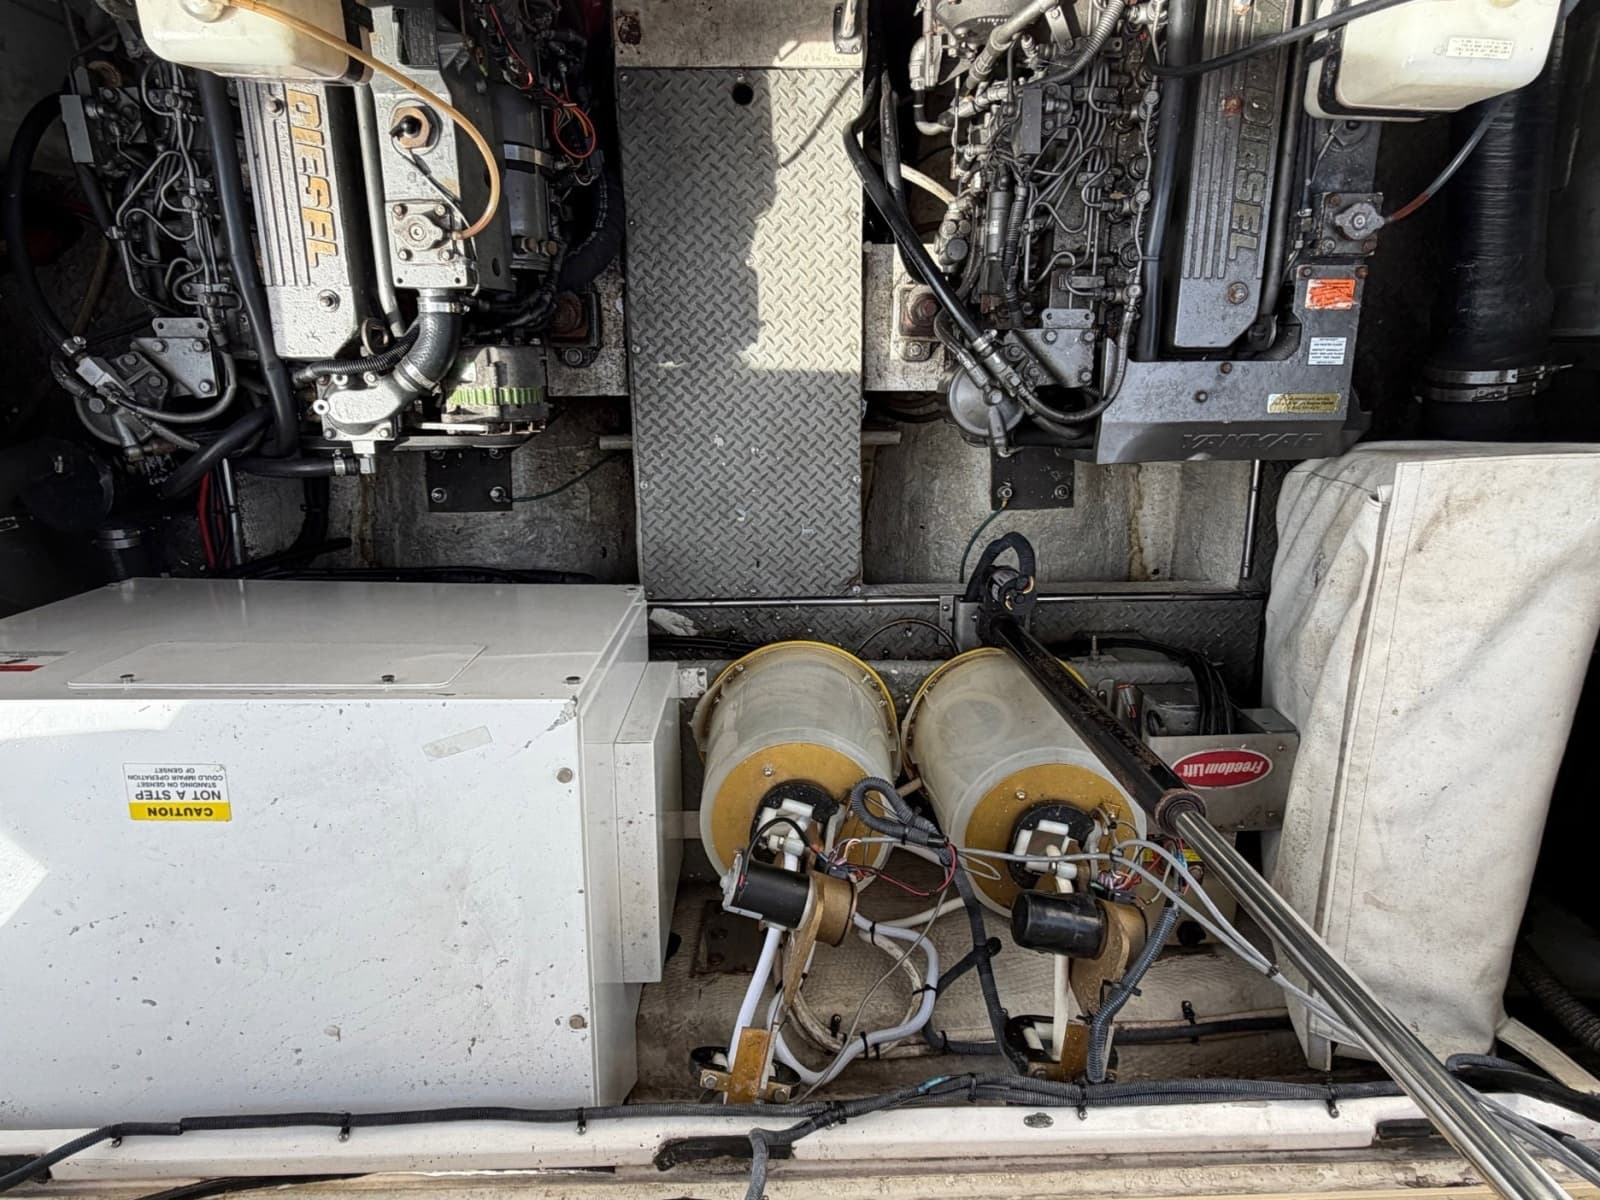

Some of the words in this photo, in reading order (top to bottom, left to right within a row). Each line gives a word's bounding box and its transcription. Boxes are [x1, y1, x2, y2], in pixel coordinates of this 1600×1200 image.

[287, 88, 339, 267] DIESEL
[1228, 87, 1275, 260] DIESEL
[1183, 763, 1204, 777] Lift
[1204, 761, 1265, 775] Freedom
[134, 790, 171, 800] STEP
[175, 790, 186, 800] A
[192, 790, 221, 800] NOT
[146, 807, 214, 817] CAUTION
